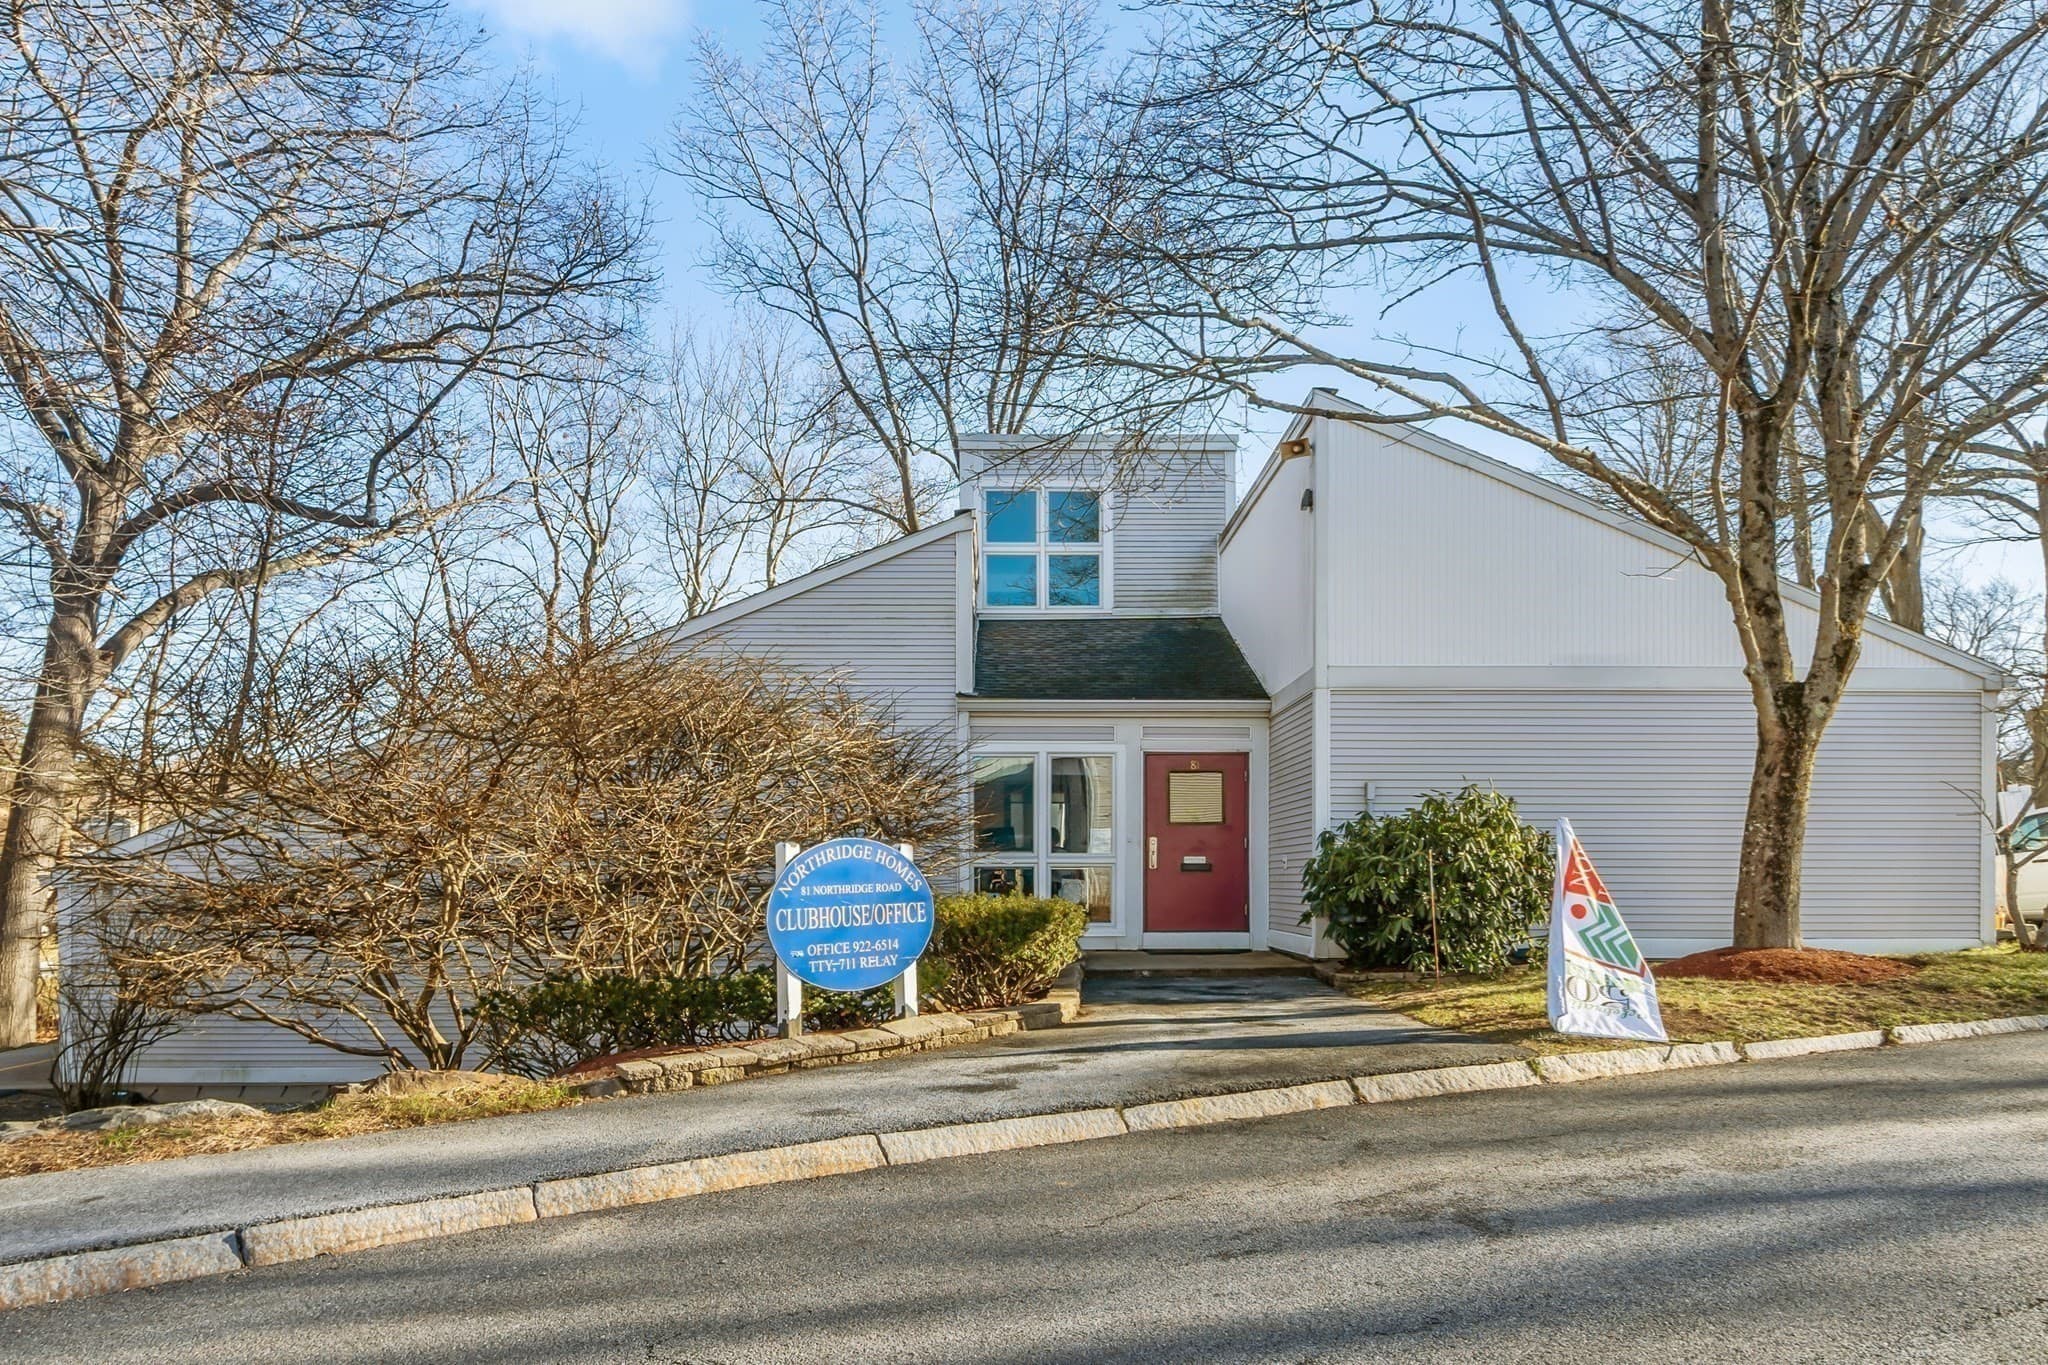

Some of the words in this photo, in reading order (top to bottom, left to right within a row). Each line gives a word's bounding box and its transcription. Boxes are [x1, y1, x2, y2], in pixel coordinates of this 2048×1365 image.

[778, 844, 873, 898] NORTHRIDGE
[875, 850, 923, 892] HOMES
[801, 885, 810, 895] 81
[813, 883, 873, 895] NORTHRIDGE
[875, 882, 902, 893] ROAD
[775, 902, 927, 932] CLUBHOUSE/OFFICE
[807, 942, 850, 956] OFFICE
[852, 939, 899, 952] 922-6514
[860, 955, 898, 969] RELAY
